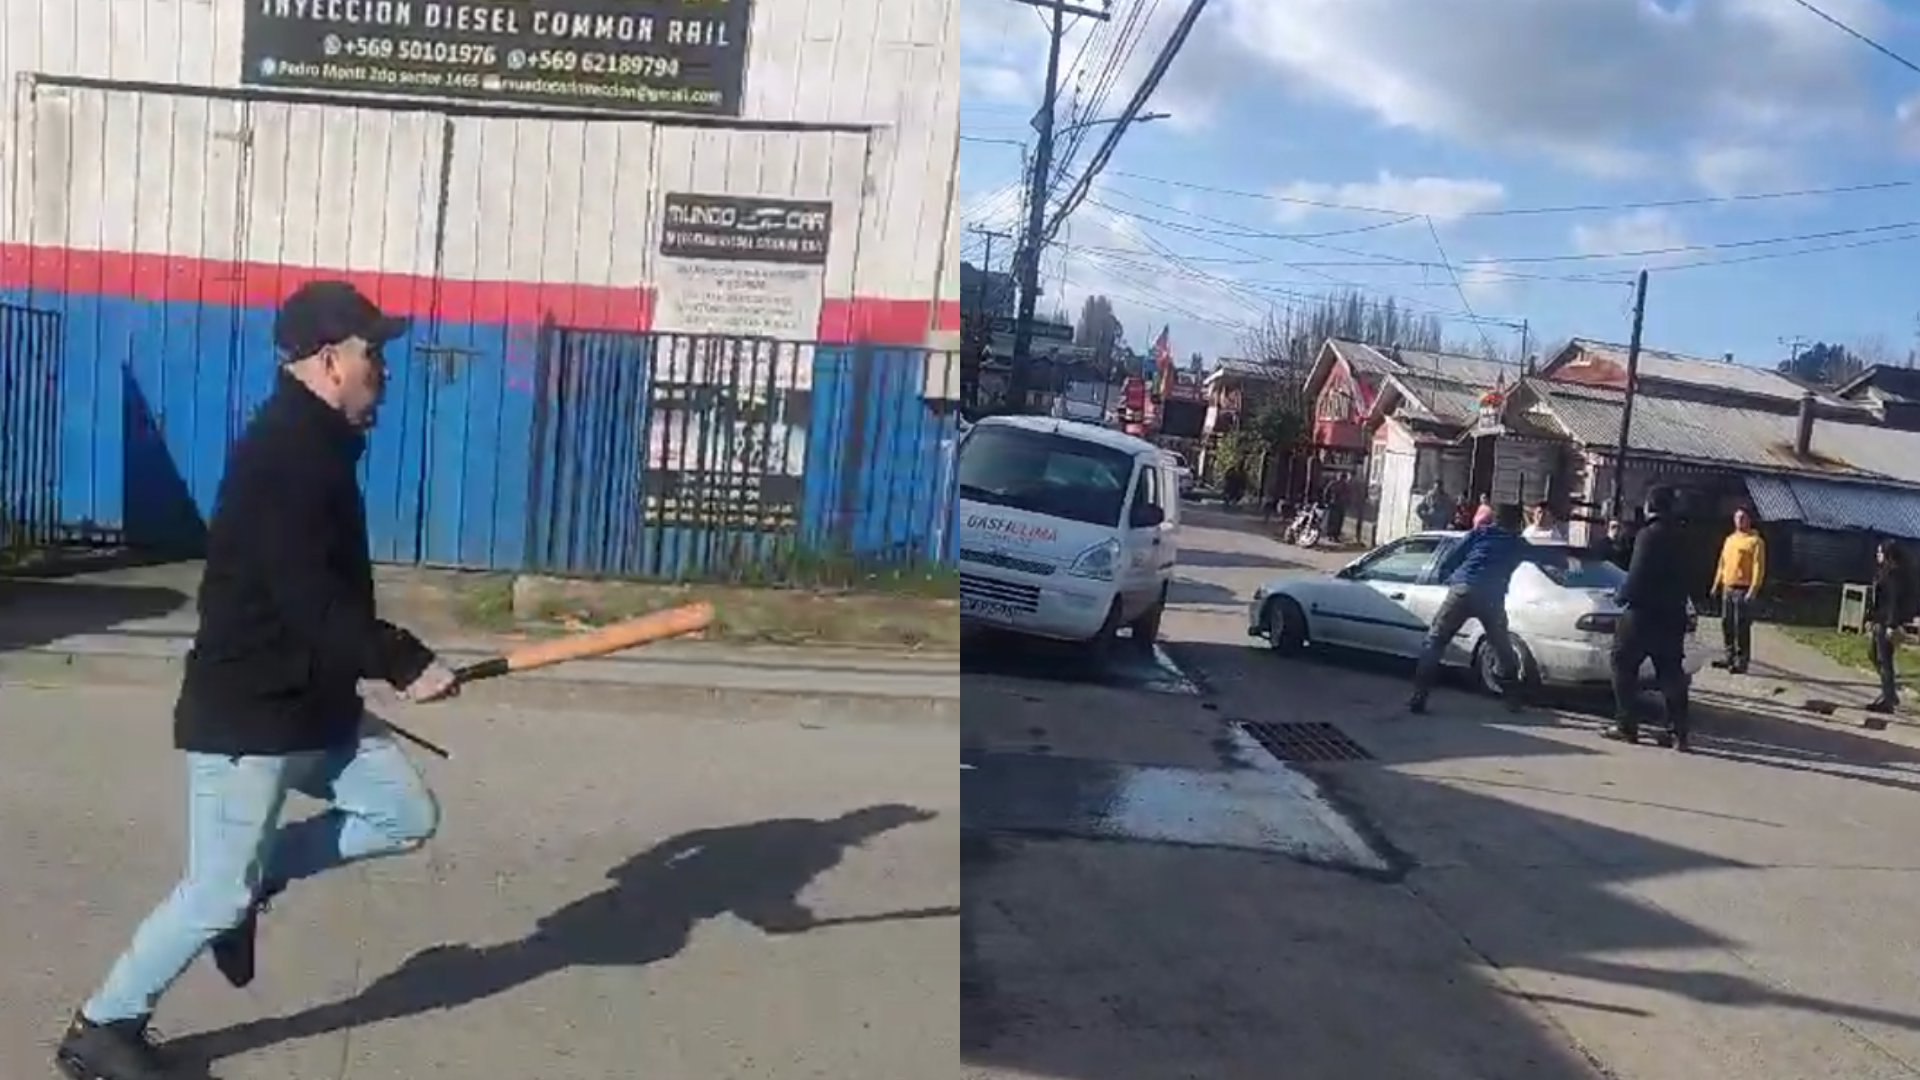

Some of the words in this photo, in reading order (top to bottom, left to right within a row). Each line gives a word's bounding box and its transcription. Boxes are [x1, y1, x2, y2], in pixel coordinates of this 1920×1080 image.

[425, 3, 519, 34] DIESEL
[533, 11, 654, 43] COMMON
[667, 20, 730, 46] RAIL
[344, 36, 393, 57] +569
[398, 39, 497, 65] 50101976
[527, 49, 577, 71] +569
[581, 52, 680, 78] 62189794
[278, 60, 320, 76] Pedro
